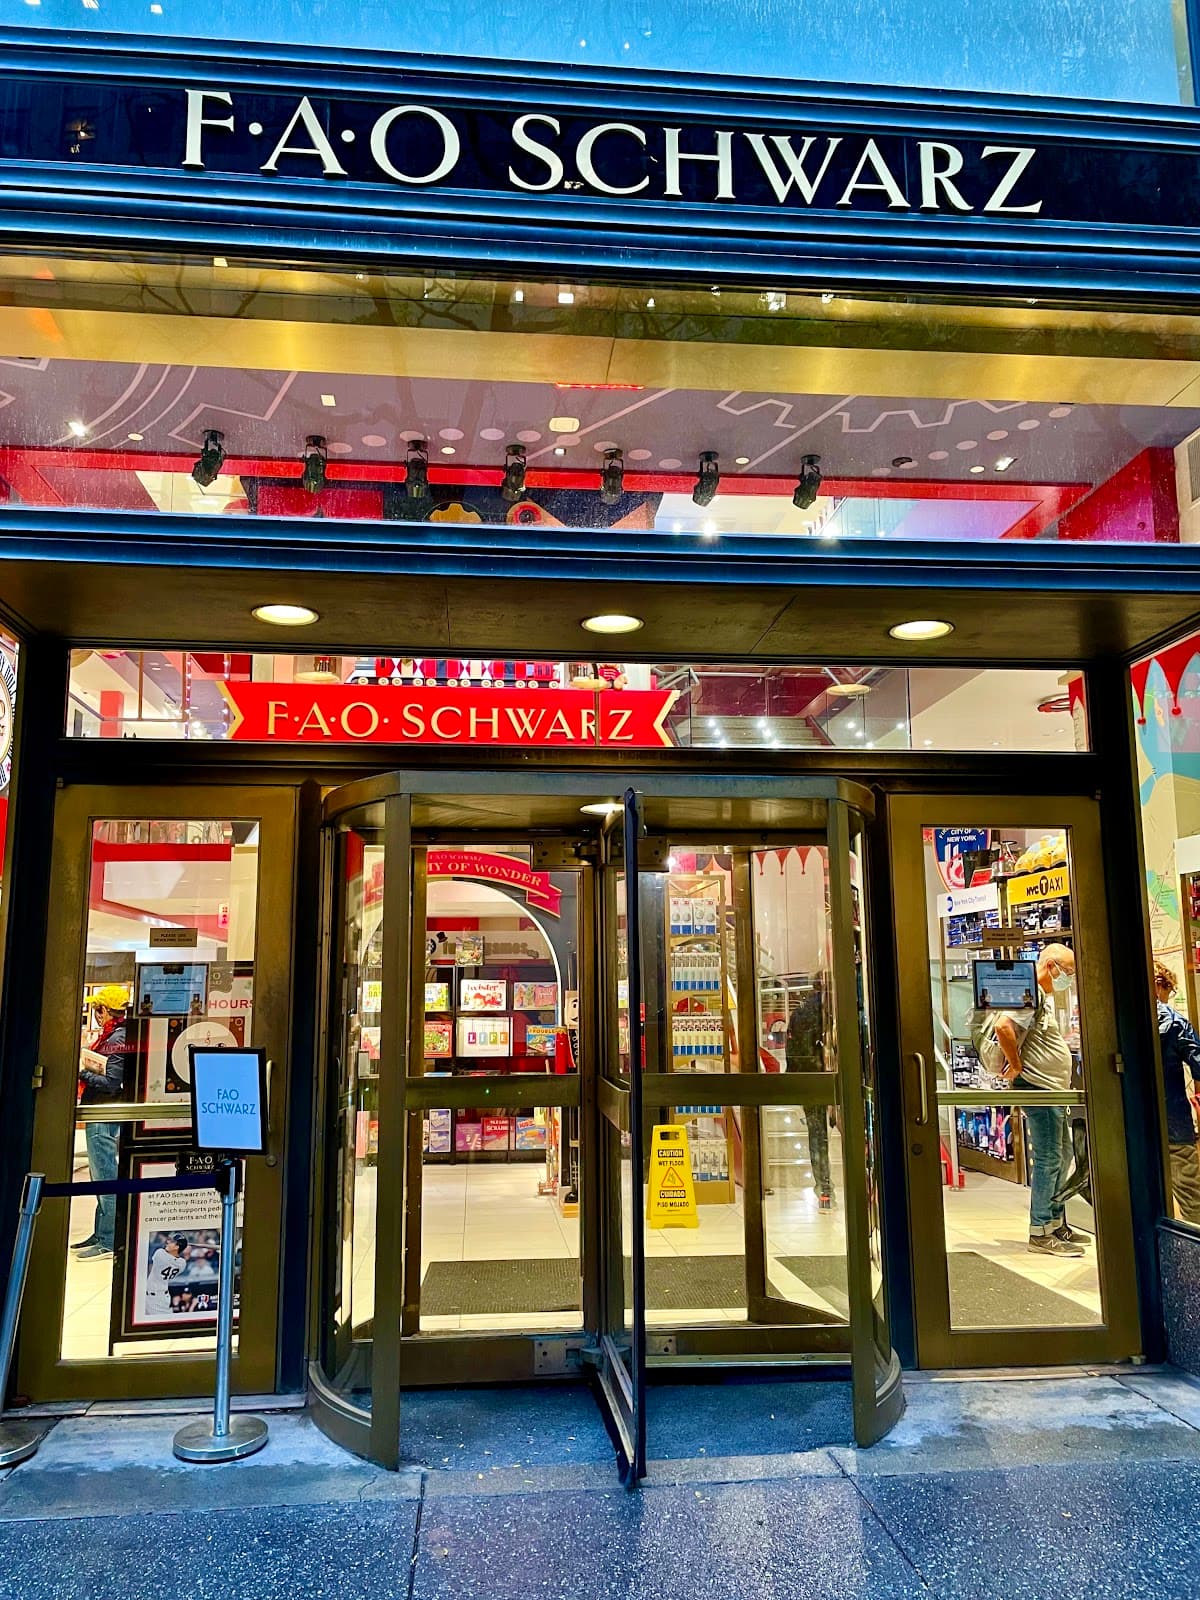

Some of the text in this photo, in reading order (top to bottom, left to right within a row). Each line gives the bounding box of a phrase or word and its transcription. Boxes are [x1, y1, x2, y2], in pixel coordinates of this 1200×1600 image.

[507, 113, 1043, 215] SCHWARZ
[402, 702, 634, 742] SCHWARZ
[961, 834, 977, 842] YORK
[447, 861, 470, 872] OF
[474, 862, 542, 887] WONDER
[1026, 875, 1064, 897] NYC TAXI
[468, 1032, 508, 1044] LIFE
[217, 1088, 240, 1101] FAO
[201, 1101, 257, 1116] SCHWARZ
[658, 1149, 684, 1157] CAUTION
[660, 1190, 685, 1198] CUIDADO
[162, 1199, 189, 1208] Anthony
[178, 1206, 207, 1215] supports
[167, 1214, 195, 1223] patients
[160, 1265, 181, 1281] 48
